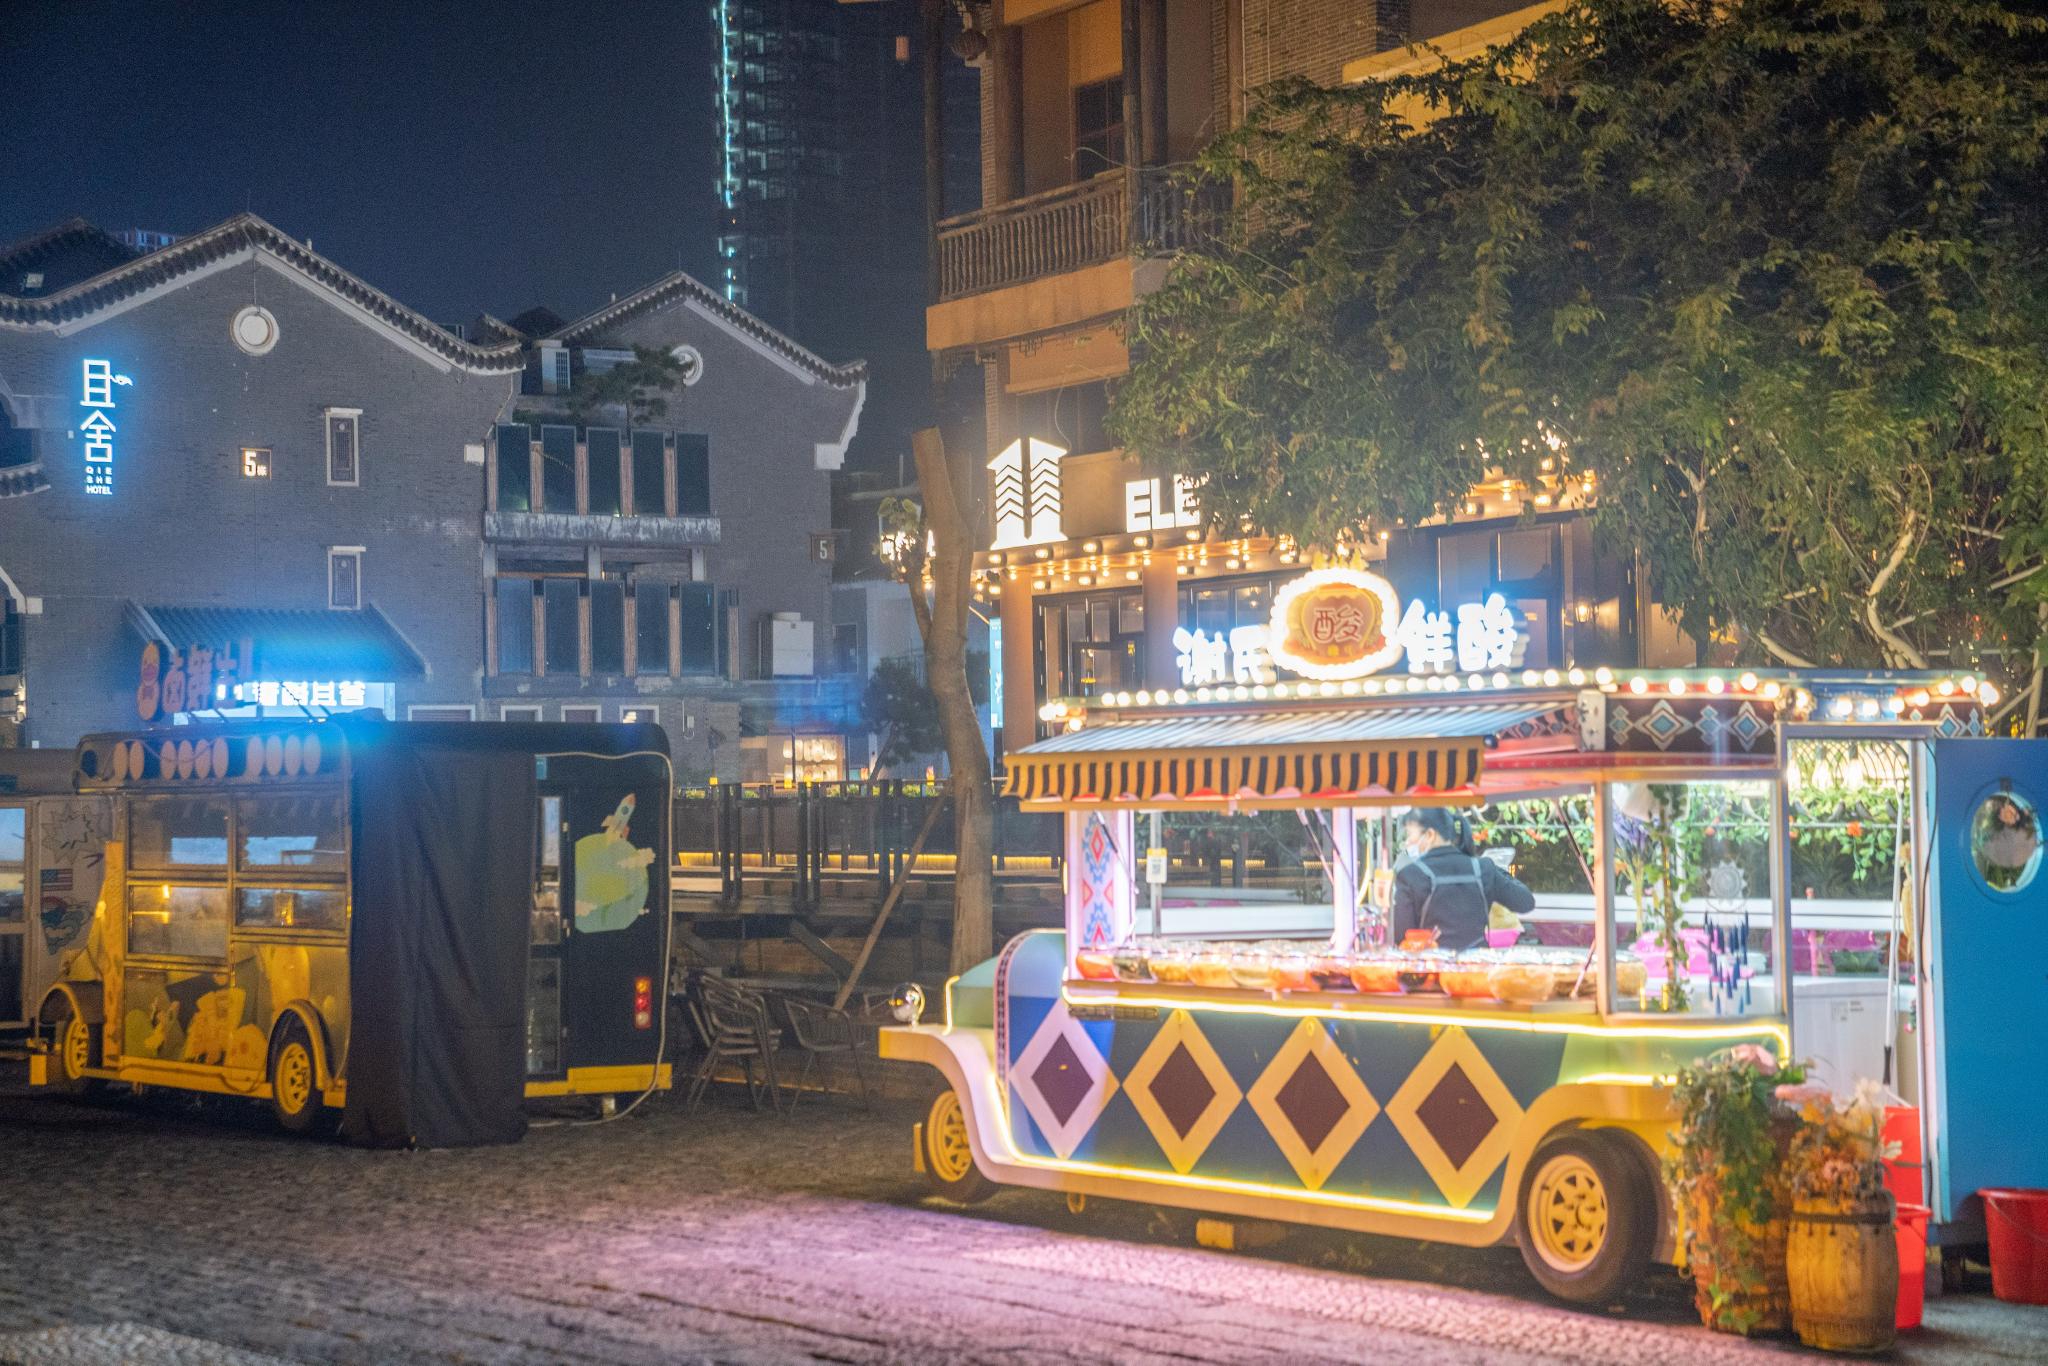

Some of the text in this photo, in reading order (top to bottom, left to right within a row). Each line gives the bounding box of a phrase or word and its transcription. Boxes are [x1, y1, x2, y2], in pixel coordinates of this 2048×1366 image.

[80, 359, 117, 462] 且舍
[86, 466, 112, 475] QIE
[86, 475, 112, 485] SHE
[86, 485, 112, 495] HOTEL
[1312, 604, 1364, 643] 酸
